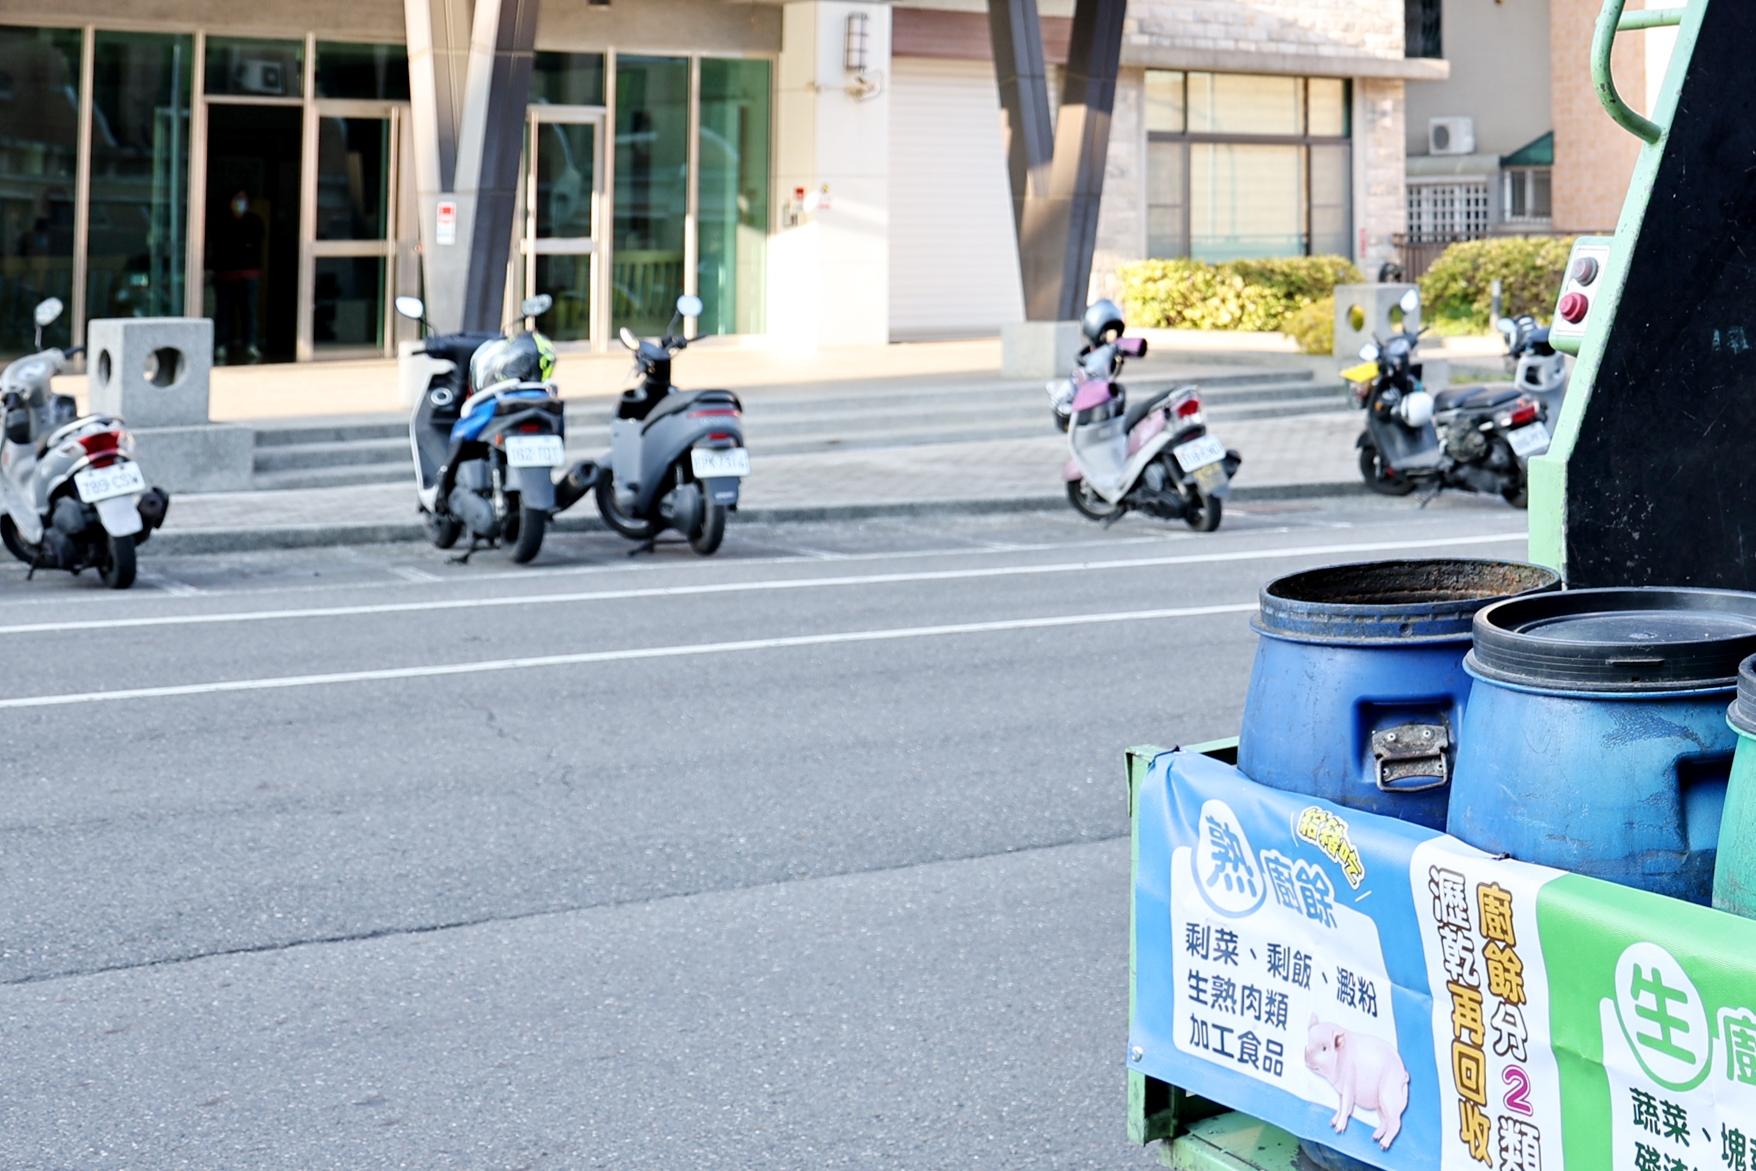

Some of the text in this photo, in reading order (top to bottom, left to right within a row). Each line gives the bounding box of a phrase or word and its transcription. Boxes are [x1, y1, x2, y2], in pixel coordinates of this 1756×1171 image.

[1205, 815, 1338, 929] 熟 廚餘
[1300, 807, 1363, 886] 給豬吃
[1188, 968, 1289, 1031] 生熟肉類
[1189, 1012, 1284, 1077] 加工食品
[1428, 865, 1493, 1169] 瀝乾再回收
[1629, 962, 1696, 1066] 生
